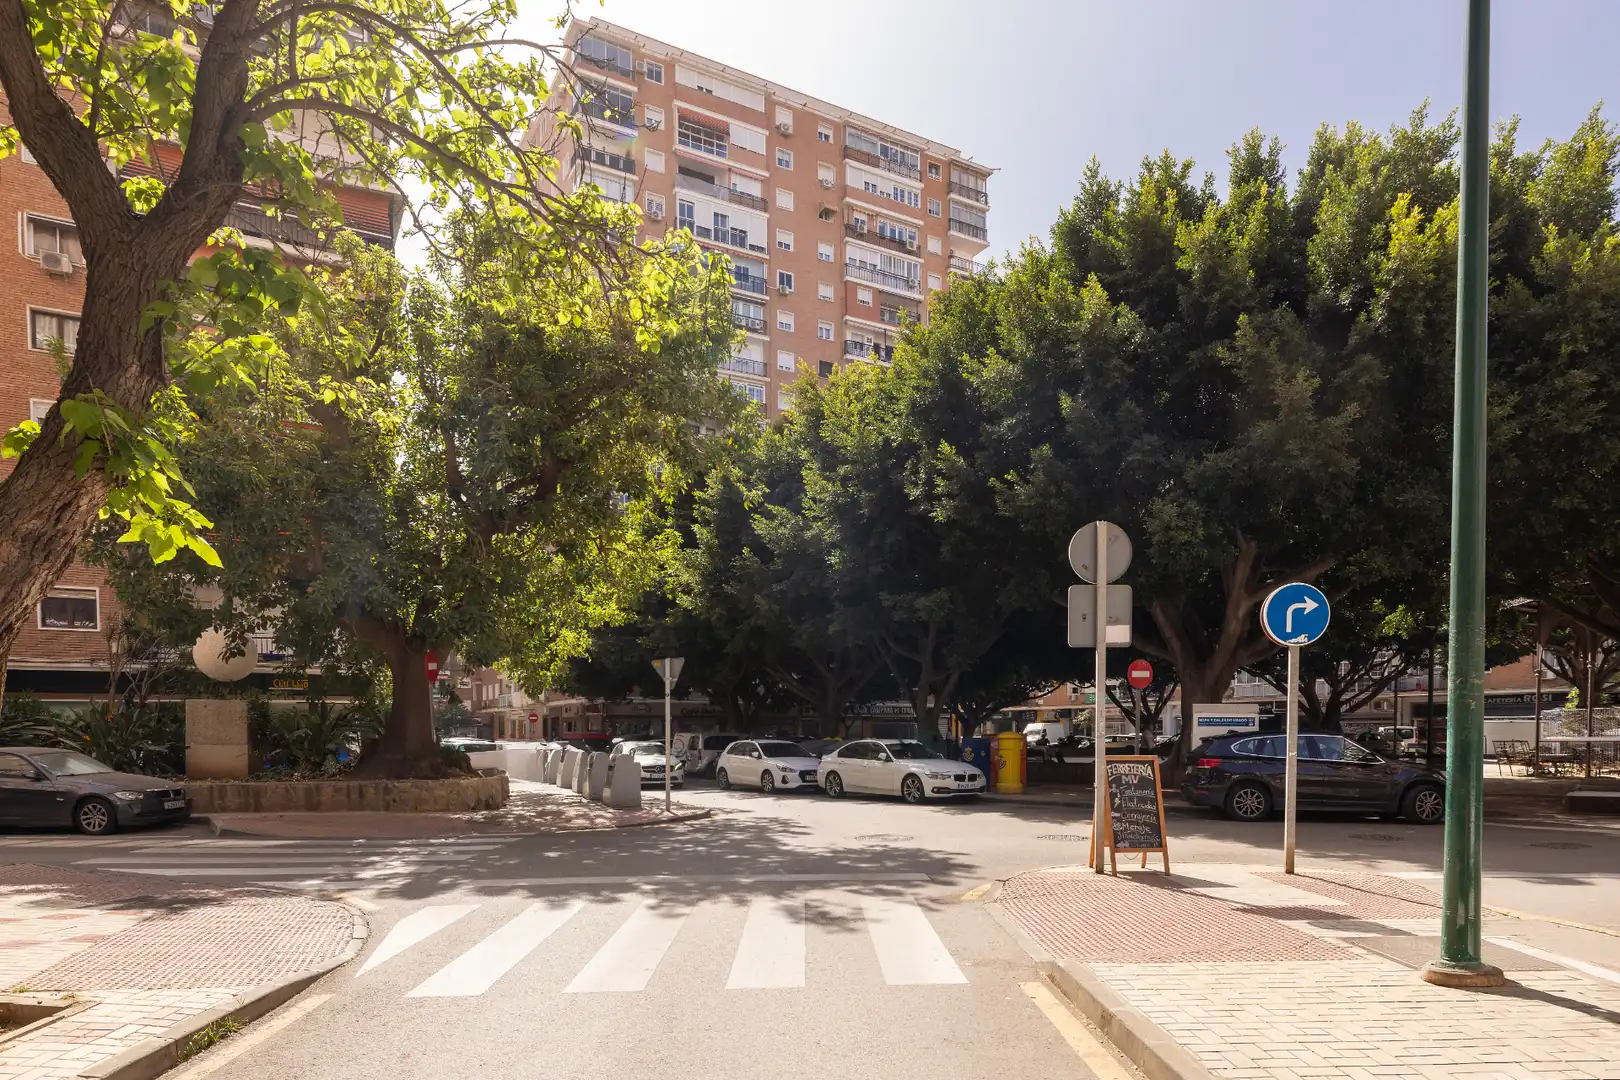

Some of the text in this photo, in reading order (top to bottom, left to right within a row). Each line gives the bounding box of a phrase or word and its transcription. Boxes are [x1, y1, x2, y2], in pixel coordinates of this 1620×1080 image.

[1523, 694, 1552, 702] ROSI
[1106, 763, 1154, 777] FERRETERÍA
[1121, 775, 1139, 784] MV
[1122, 822, 1151, 834] Menaje
